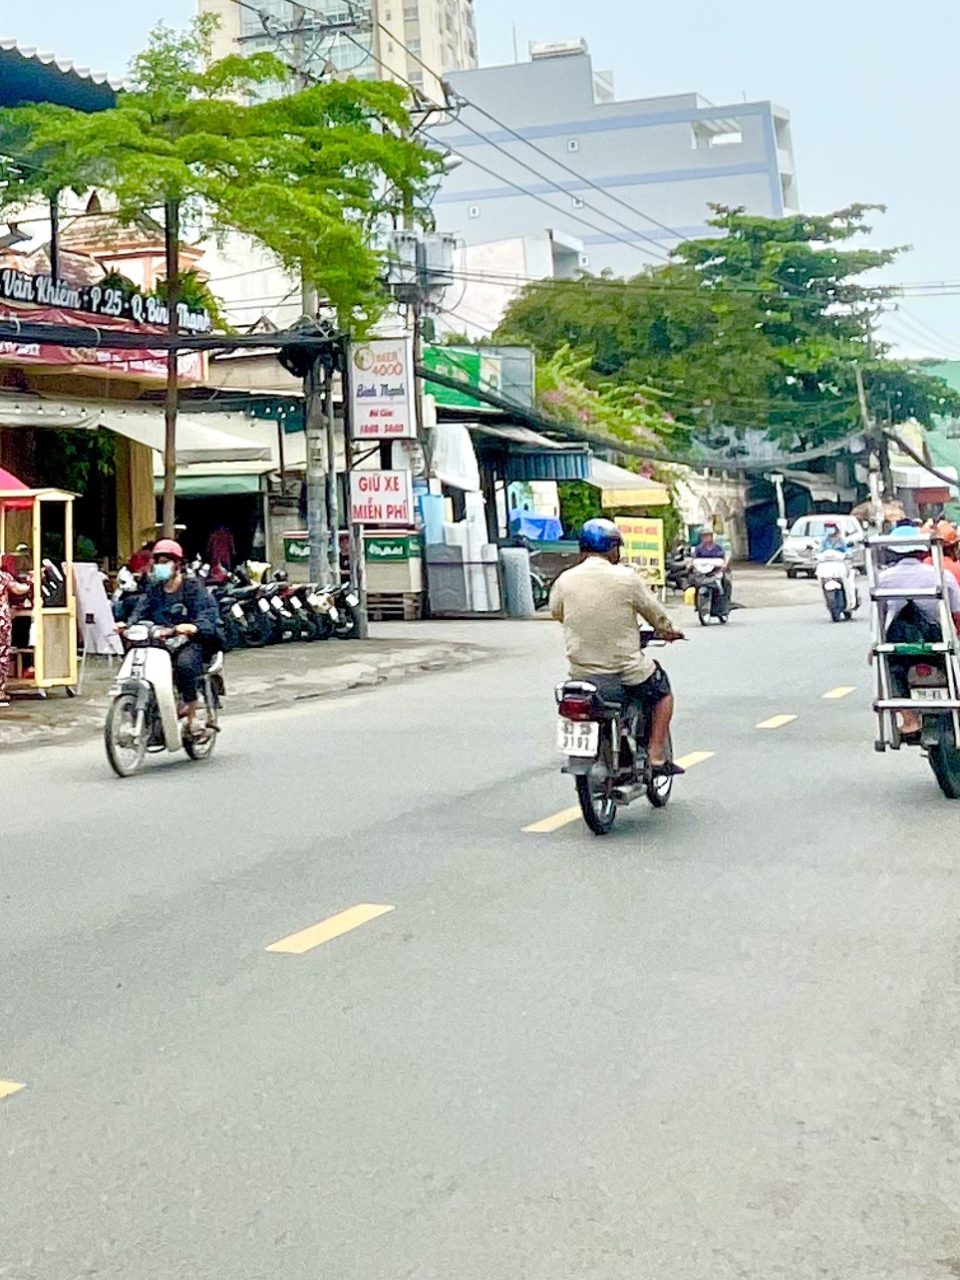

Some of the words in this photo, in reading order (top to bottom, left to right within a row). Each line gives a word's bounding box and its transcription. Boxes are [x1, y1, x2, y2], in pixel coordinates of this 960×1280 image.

[372, 362, 403, 376] 4000
[358, 473, 380, 491] GIỮ
[384, 476, 400, 491] XE
[386, 500, 408, 519] PHÍ
